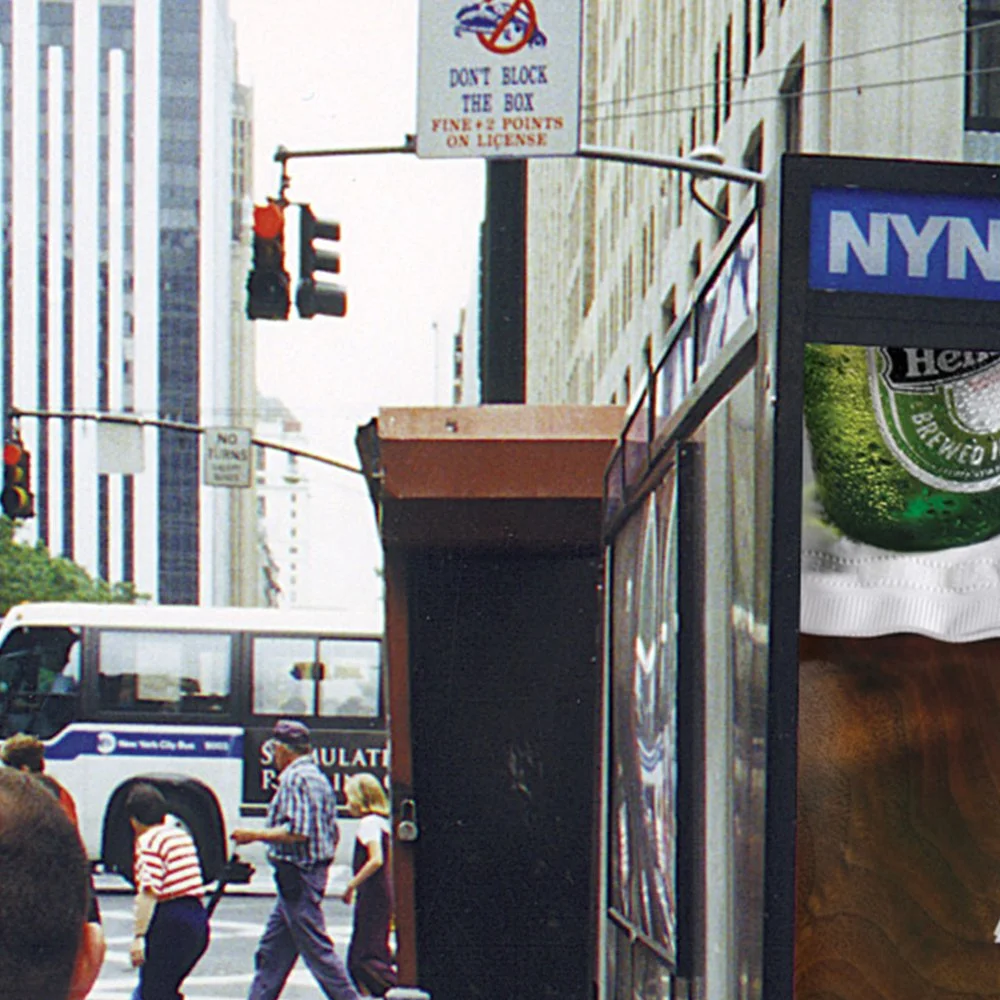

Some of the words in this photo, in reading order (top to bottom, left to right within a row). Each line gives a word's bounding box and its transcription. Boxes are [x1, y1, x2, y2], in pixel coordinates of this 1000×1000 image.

[450, 67, 491, 88] DON'T
[502, 65, 548, 85] BLOCK
[461, 93, 492, 113] THE
[504, 92, 534, 112] BOX
[502, 116, 564, 131] POINTS
[446, 134, 469, 149] ON
[477, 132, 548, 149] LICENSE
[217, 432, 238, 445] NO
[911, 410, 985, 466] BREWED
